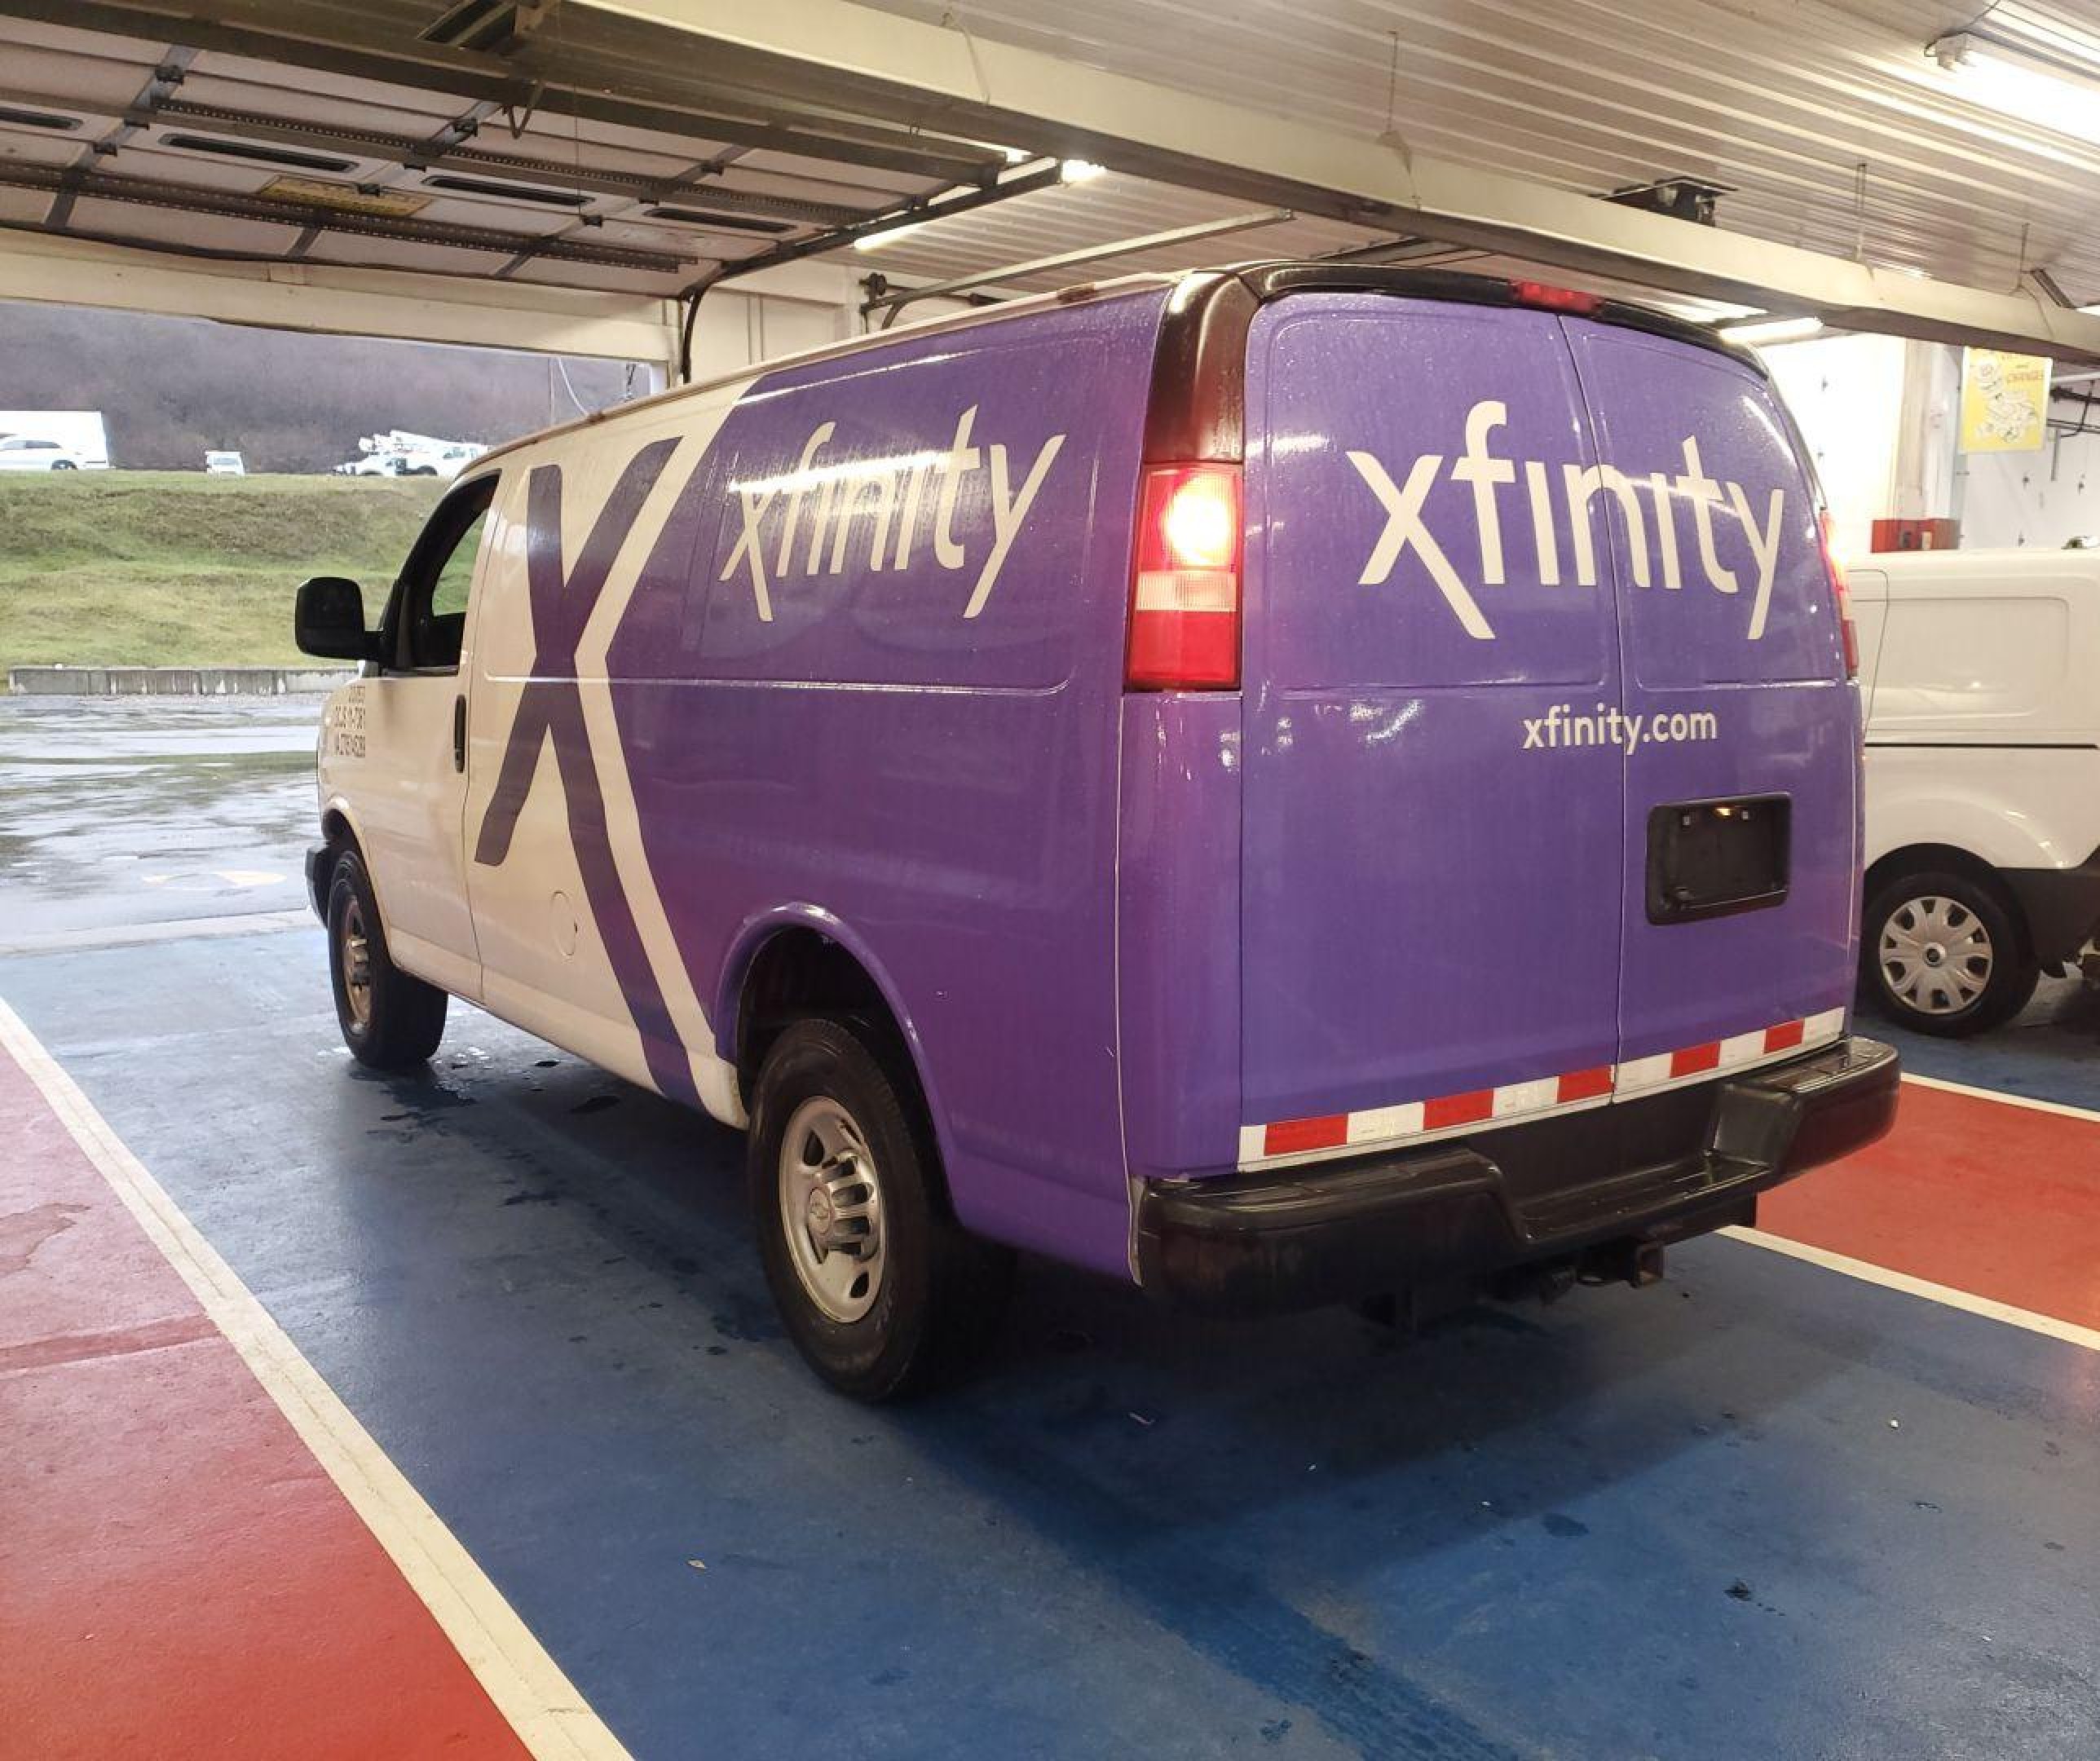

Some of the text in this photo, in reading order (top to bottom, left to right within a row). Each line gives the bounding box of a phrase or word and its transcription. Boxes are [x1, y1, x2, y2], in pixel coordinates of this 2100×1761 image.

[718, 404, 1066, 621] xfinity
[1345, 400, 1784, 639] xfinity
[1523, 703, 1717, 755] xfinity.com
